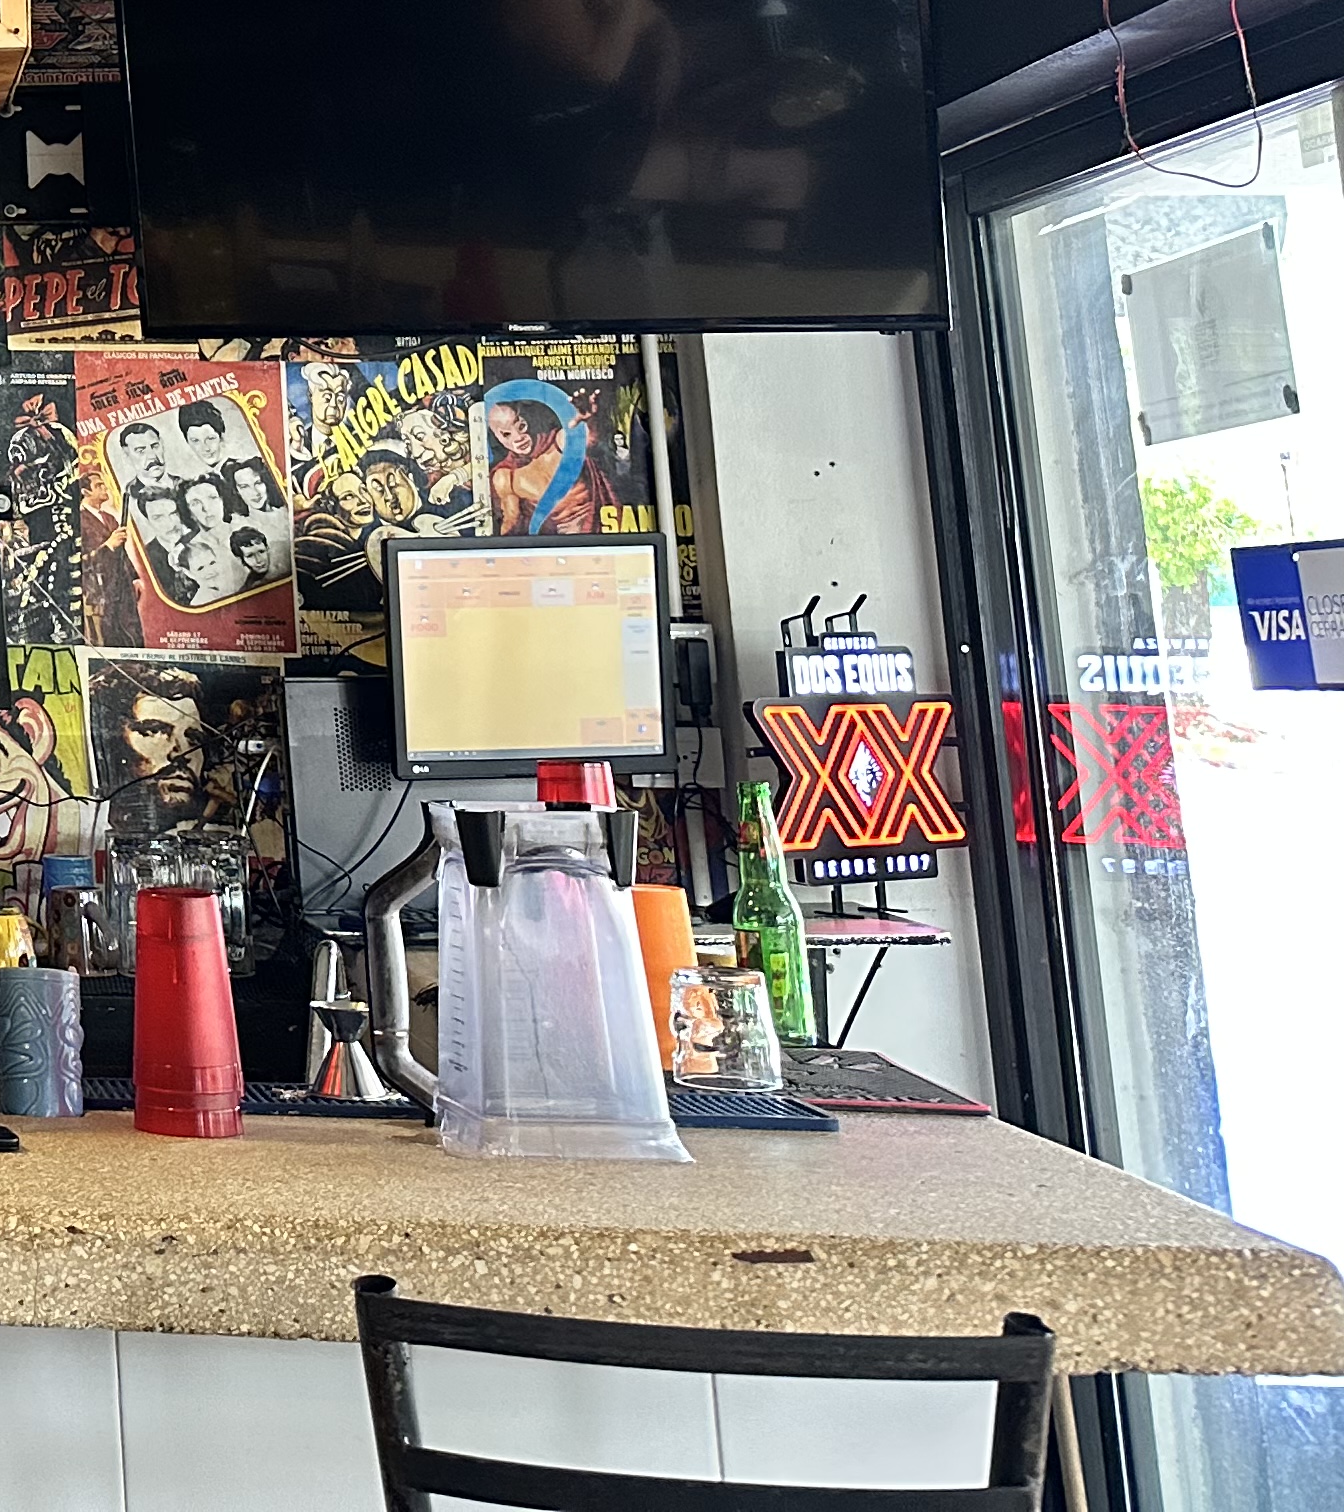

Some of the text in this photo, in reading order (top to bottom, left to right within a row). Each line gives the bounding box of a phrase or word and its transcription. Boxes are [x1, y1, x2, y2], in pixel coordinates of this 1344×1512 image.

[5, 268, 86, 321] PEPE
[76, 417, 104, 437] UNA
[166, 387, 186, 408] DE
[184, 371, 240, 402] TANTAS
[330, 372, 402, 465] ALEGRE
[823, 636, 876, 651] CERVEZA
[1248, 609, 1307, 641] VISA
[792, 652, 913, 696] DOS EQUIS
[760, 700, 968, 851] XX
